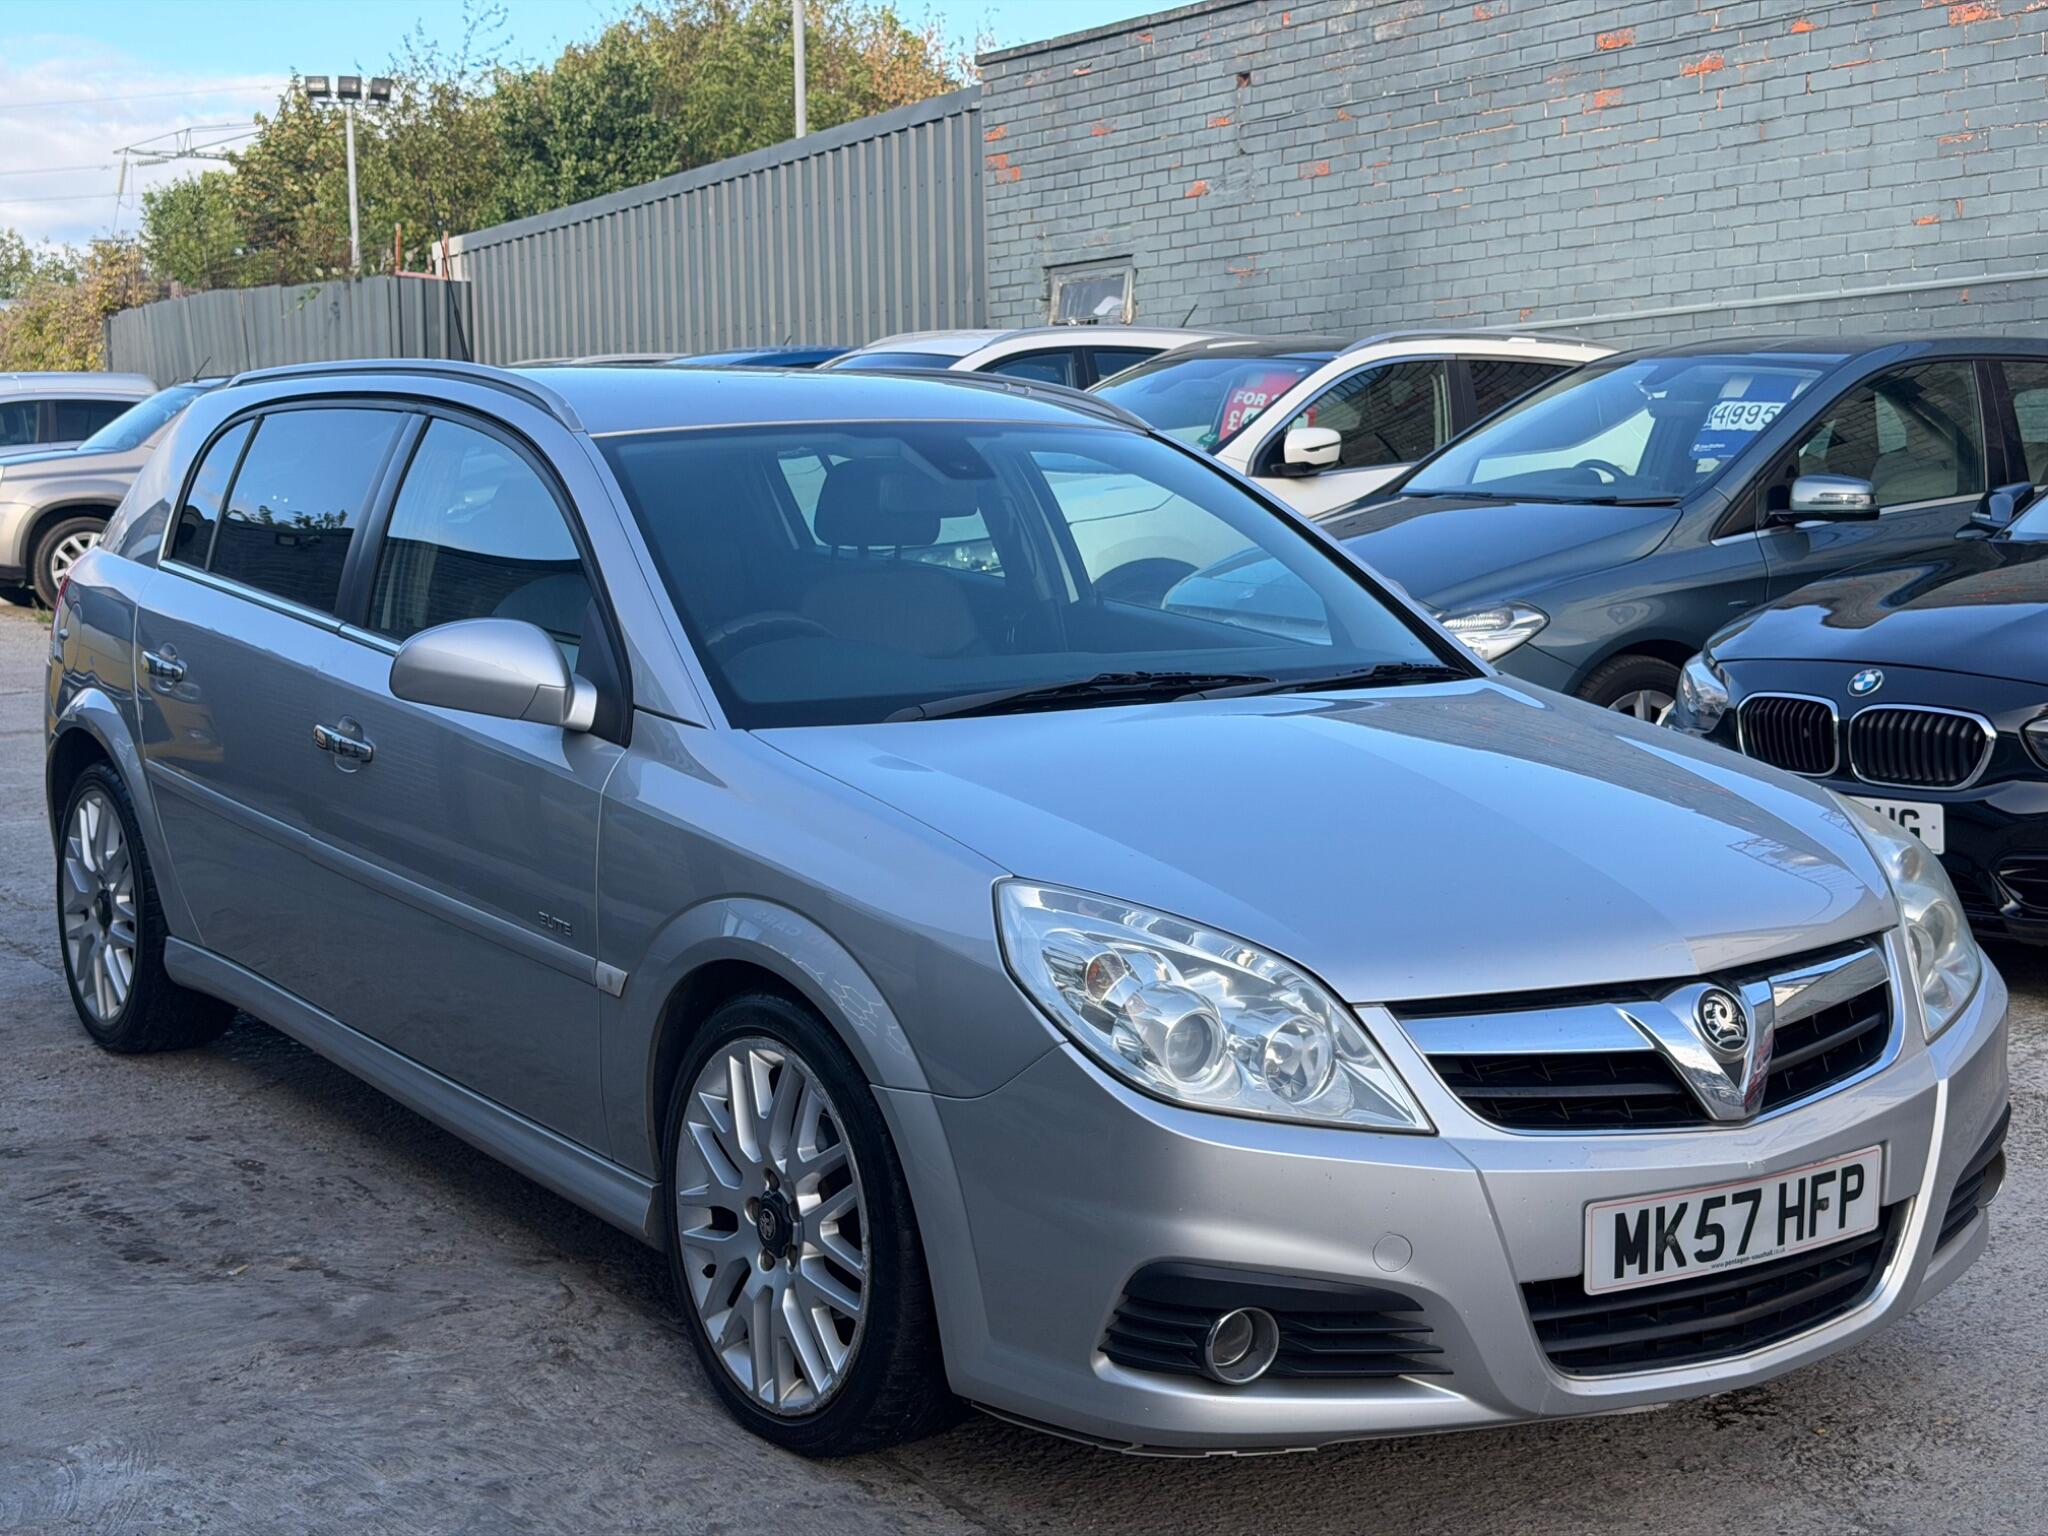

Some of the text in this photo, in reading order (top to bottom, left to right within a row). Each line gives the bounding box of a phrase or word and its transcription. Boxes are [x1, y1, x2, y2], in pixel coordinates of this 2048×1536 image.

[1232, 389, 1267, 406] FOR
[1613, 1163, 1865, 1279] MK57 HFP
